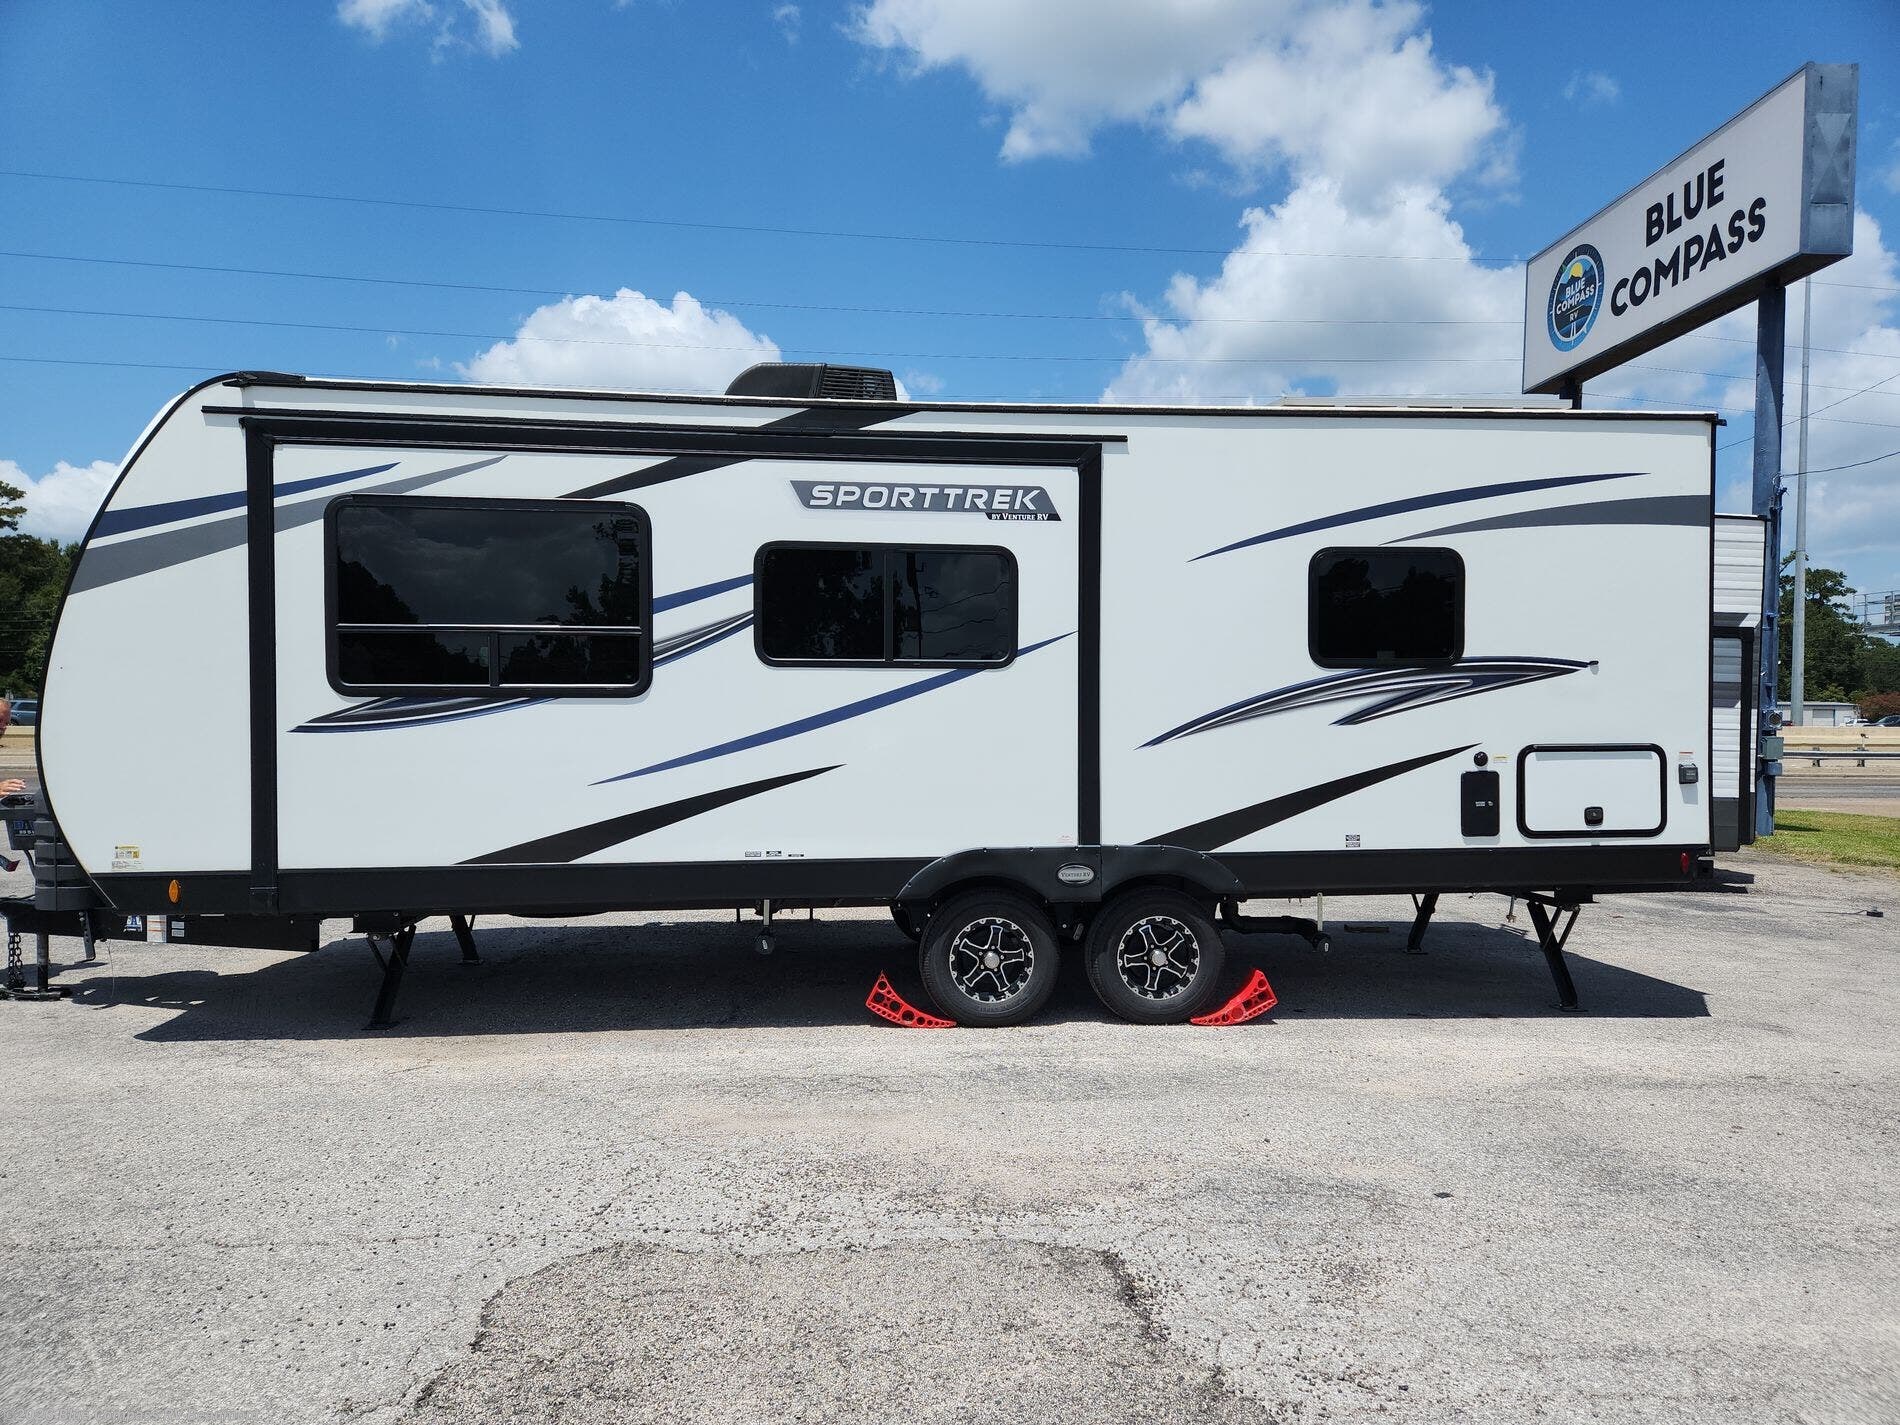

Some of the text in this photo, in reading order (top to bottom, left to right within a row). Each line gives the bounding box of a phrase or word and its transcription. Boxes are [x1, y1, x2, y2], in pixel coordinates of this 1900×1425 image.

[1646, 158, 1725, 248] BLUE
[1610, 197, 1767, 317] COMPASS
[1556, 284, 1595, 315] COMPASS
[1565, 277, 1586, 299] BLUE
[1569, 310, 1579, 322] RV
[809, 485, 1041, 510] SPORTTREK
